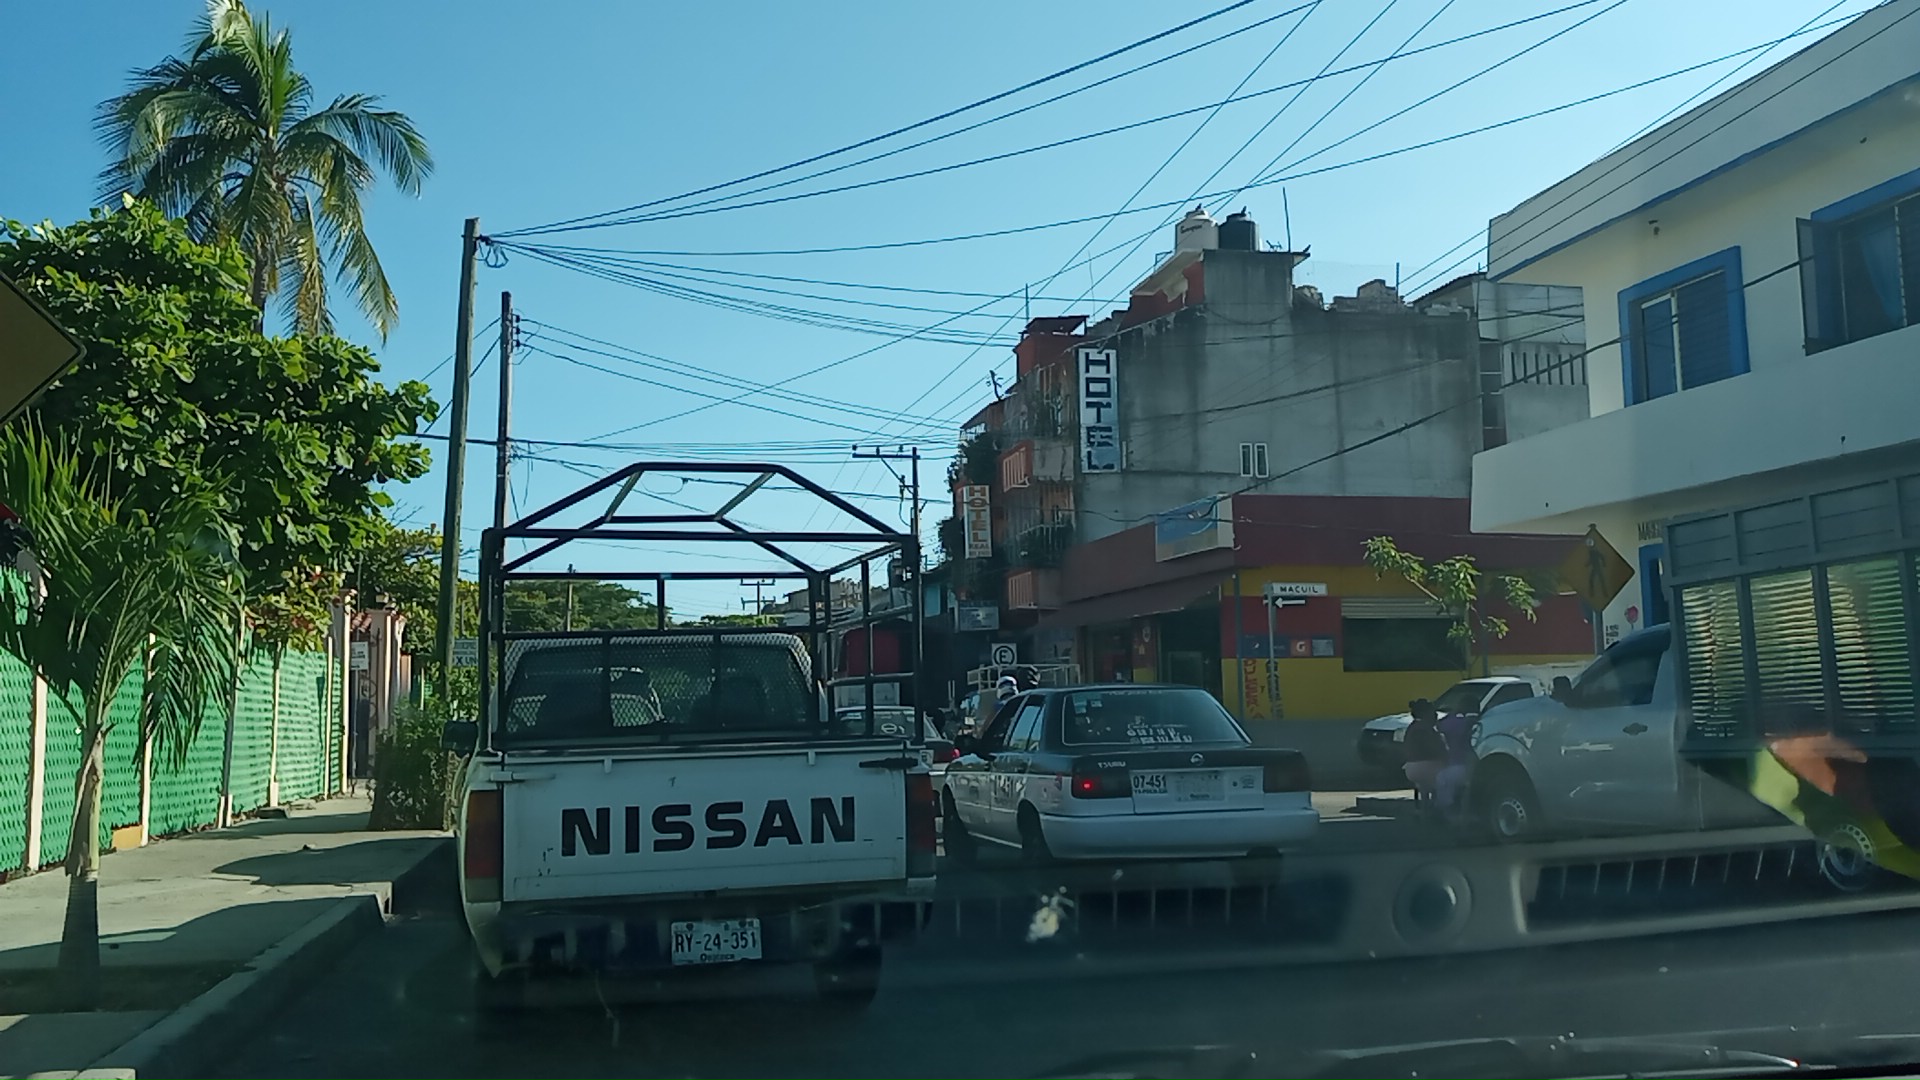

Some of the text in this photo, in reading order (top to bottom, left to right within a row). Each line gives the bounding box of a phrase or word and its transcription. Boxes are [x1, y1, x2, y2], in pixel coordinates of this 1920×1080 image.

[1084, 352, 1115, 470] HOTEL
[968, 486, 988, 542] HOTEL
[1279, 585, 1319, 594] MACUIL
[999, 649, 1009, 665] E
[1133, 774, 1167, 789] 07-451
[561, 796, 856, 857] NISSAN
[674, 931, 756, 953] RY-24-351
